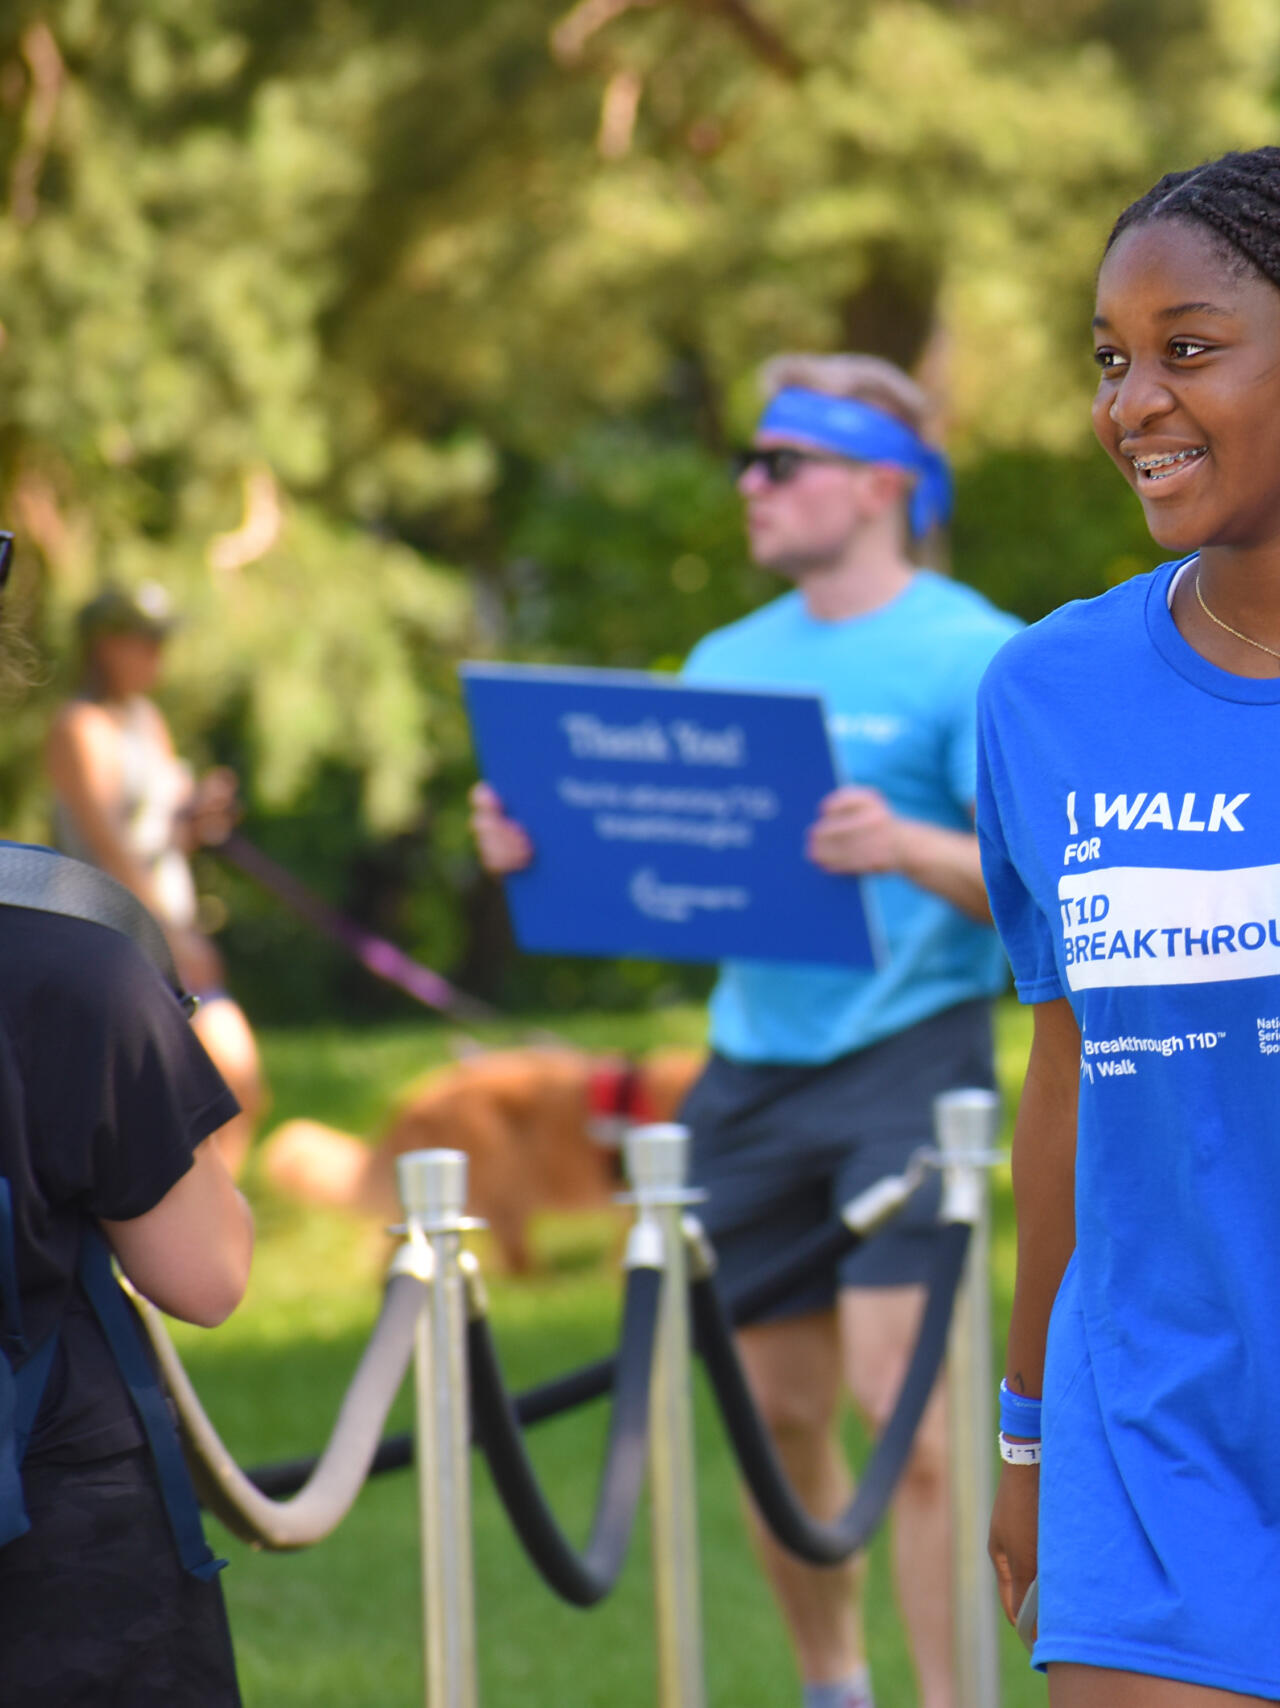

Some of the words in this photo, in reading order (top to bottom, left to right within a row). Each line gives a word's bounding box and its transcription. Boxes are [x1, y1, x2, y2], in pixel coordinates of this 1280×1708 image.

[1067, 791, 1078, 835] I
[1094, 792, 1251, 832] WALK
[1064, 837, 1101, 865] FOR
[1061, 894, 1110, 928] T1D
[1084, 1032, 1184, 1056] Breakthrough
[1097, 1059, 1137, 1078] Walk
